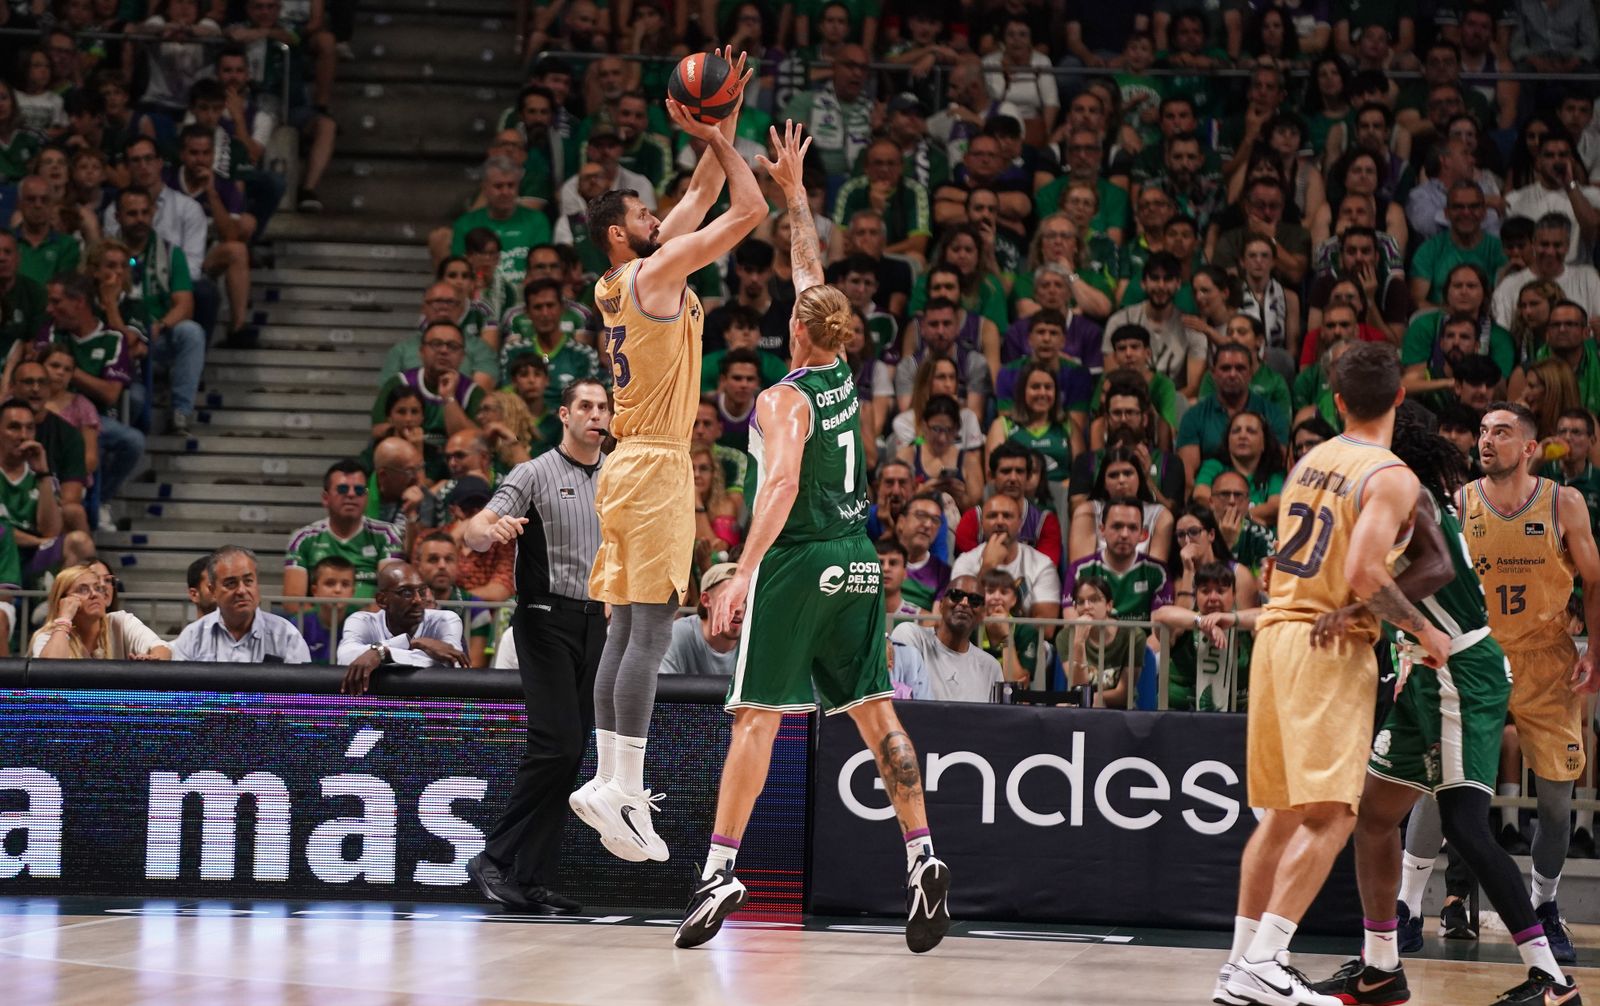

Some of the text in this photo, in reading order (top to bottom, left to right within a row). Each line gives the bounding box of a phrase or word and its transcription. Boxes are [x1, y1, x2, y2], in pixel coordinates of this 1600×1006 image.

[848, 575, 866, 583] DEL
[849, 562, 881, 574] COSTA
[1495, 584, 1527, 616] 13
[838, 731, 1266, 835] endes
[145, 729, 489, 886] más
